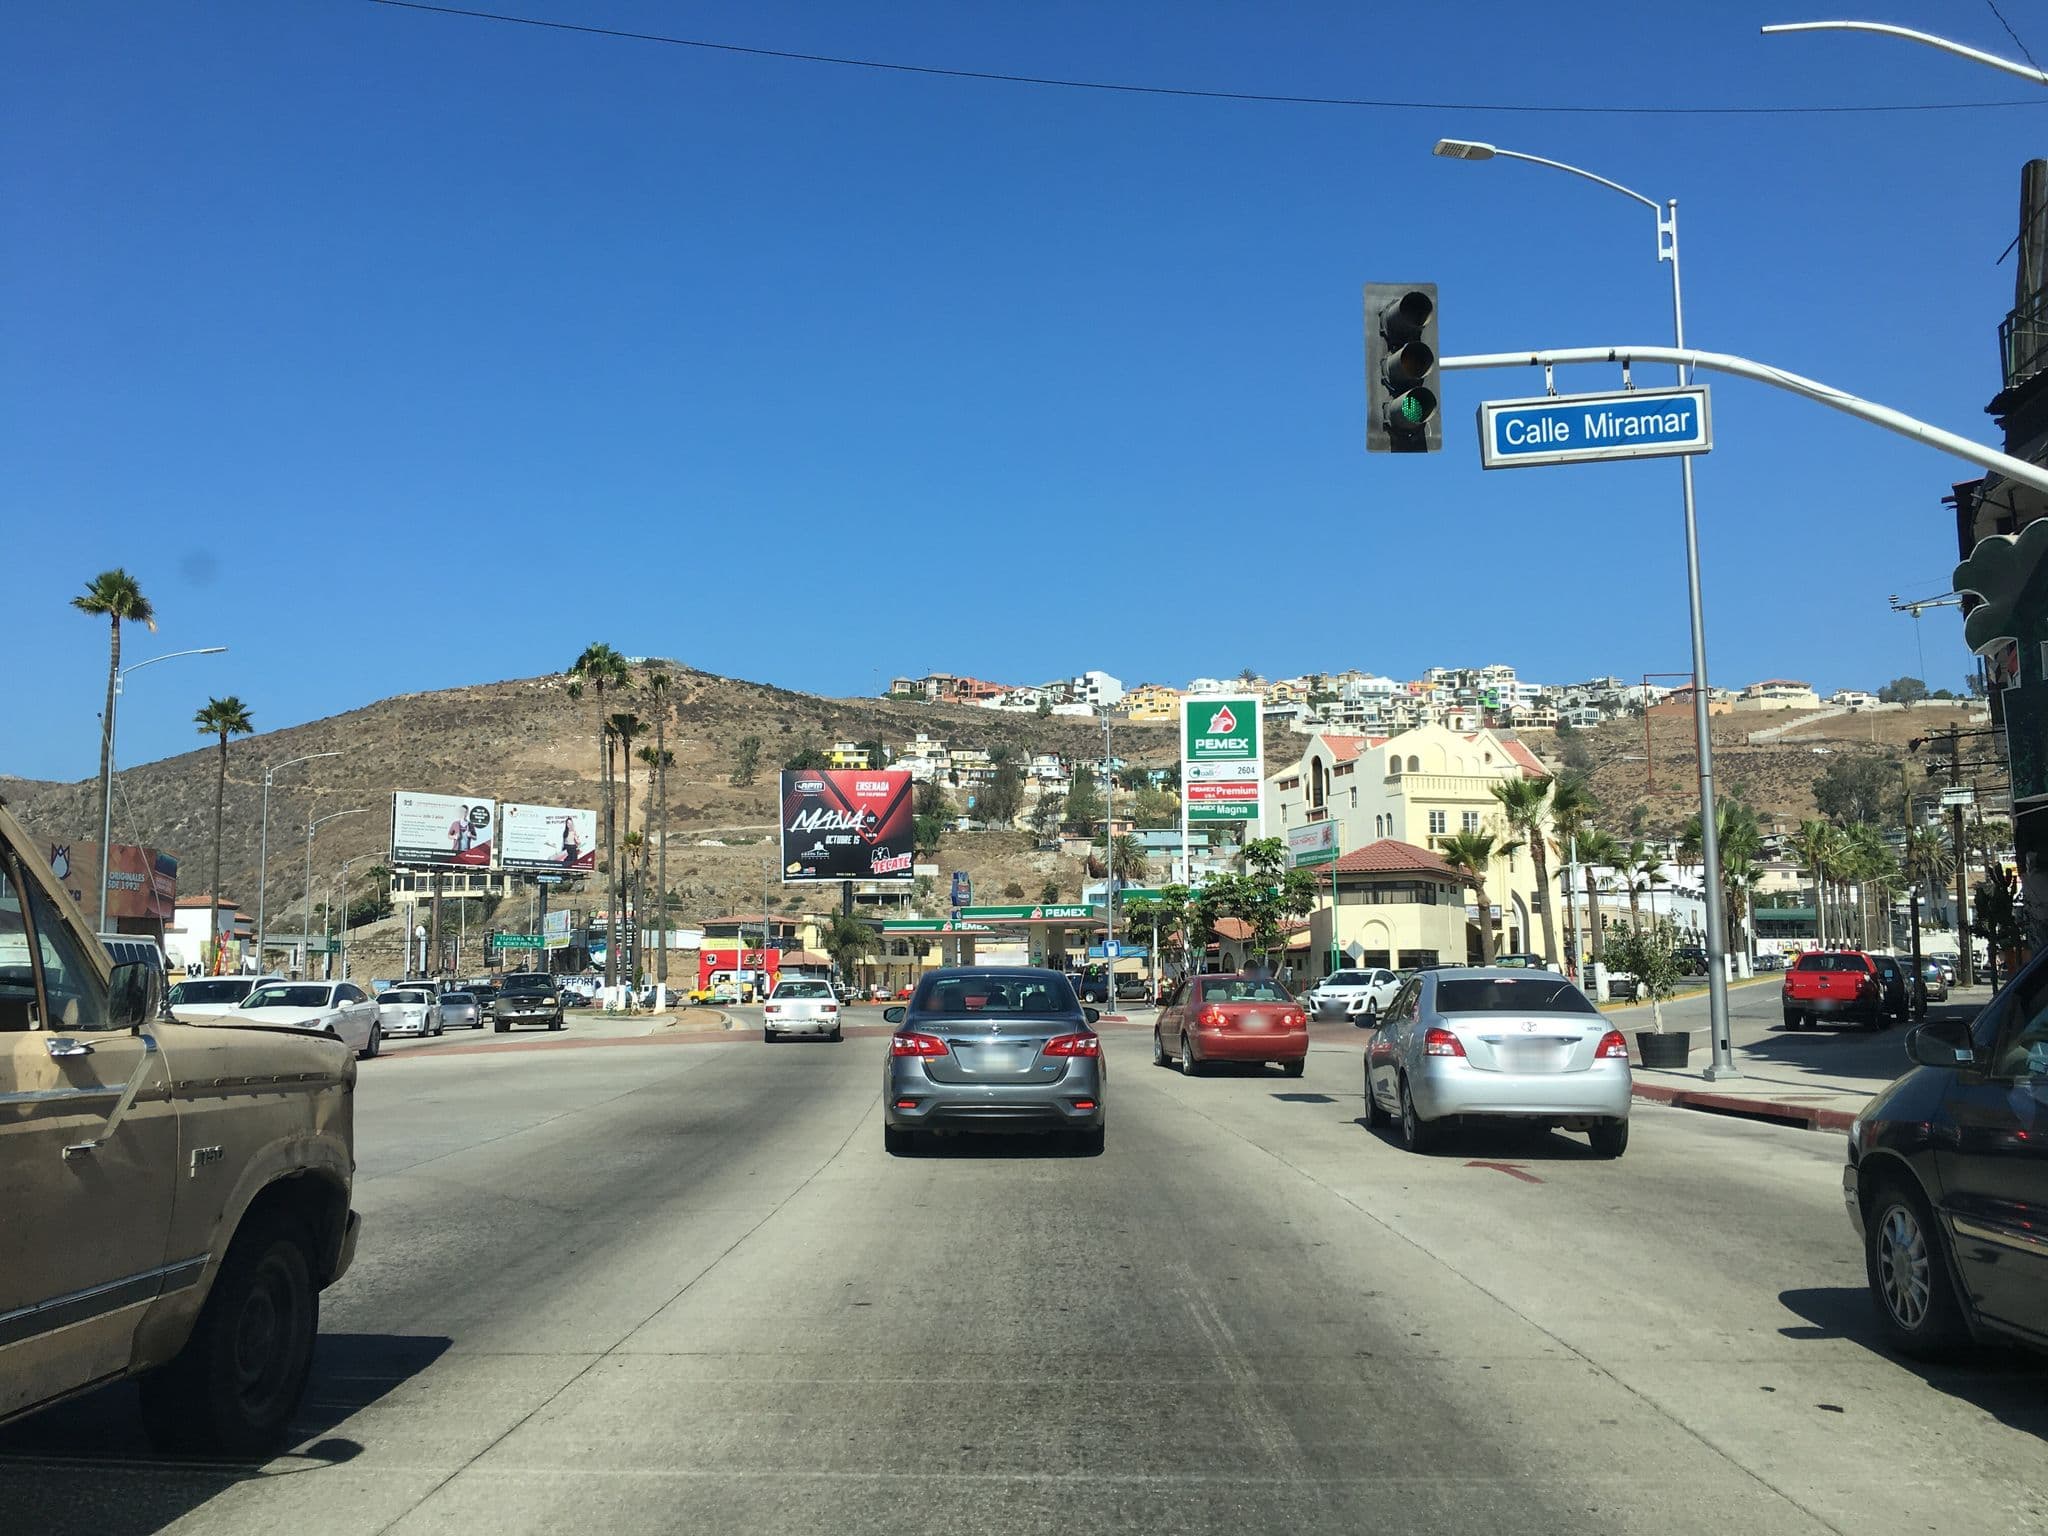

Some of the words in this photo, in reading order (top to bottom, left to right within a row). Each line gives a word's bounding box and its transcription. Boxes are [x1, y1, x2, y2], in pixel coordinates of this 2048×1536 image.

[1505, 417, 1570, 446] Calle
[1584, 410, 1691, 440] Miramar
[1195, 739, 1248, 750] PEMEX
[1237, 766, 1256, 775] 2604
[856, 782, 889, 791] ENSENADA
[1216, 785, 1257, 796] Premium
[1216, 805, 1248, 816] Magna
[787, 804, 866, 833] MANÁ
[826, 836, 852, 845] OCTUBRE
[853, 835, 861, 845] 15
[872, 857, 912, 874] TECATE
[109, 872, 145, 881] ORIGINALES
[1045, 908, 1087, 918] PEMEX
